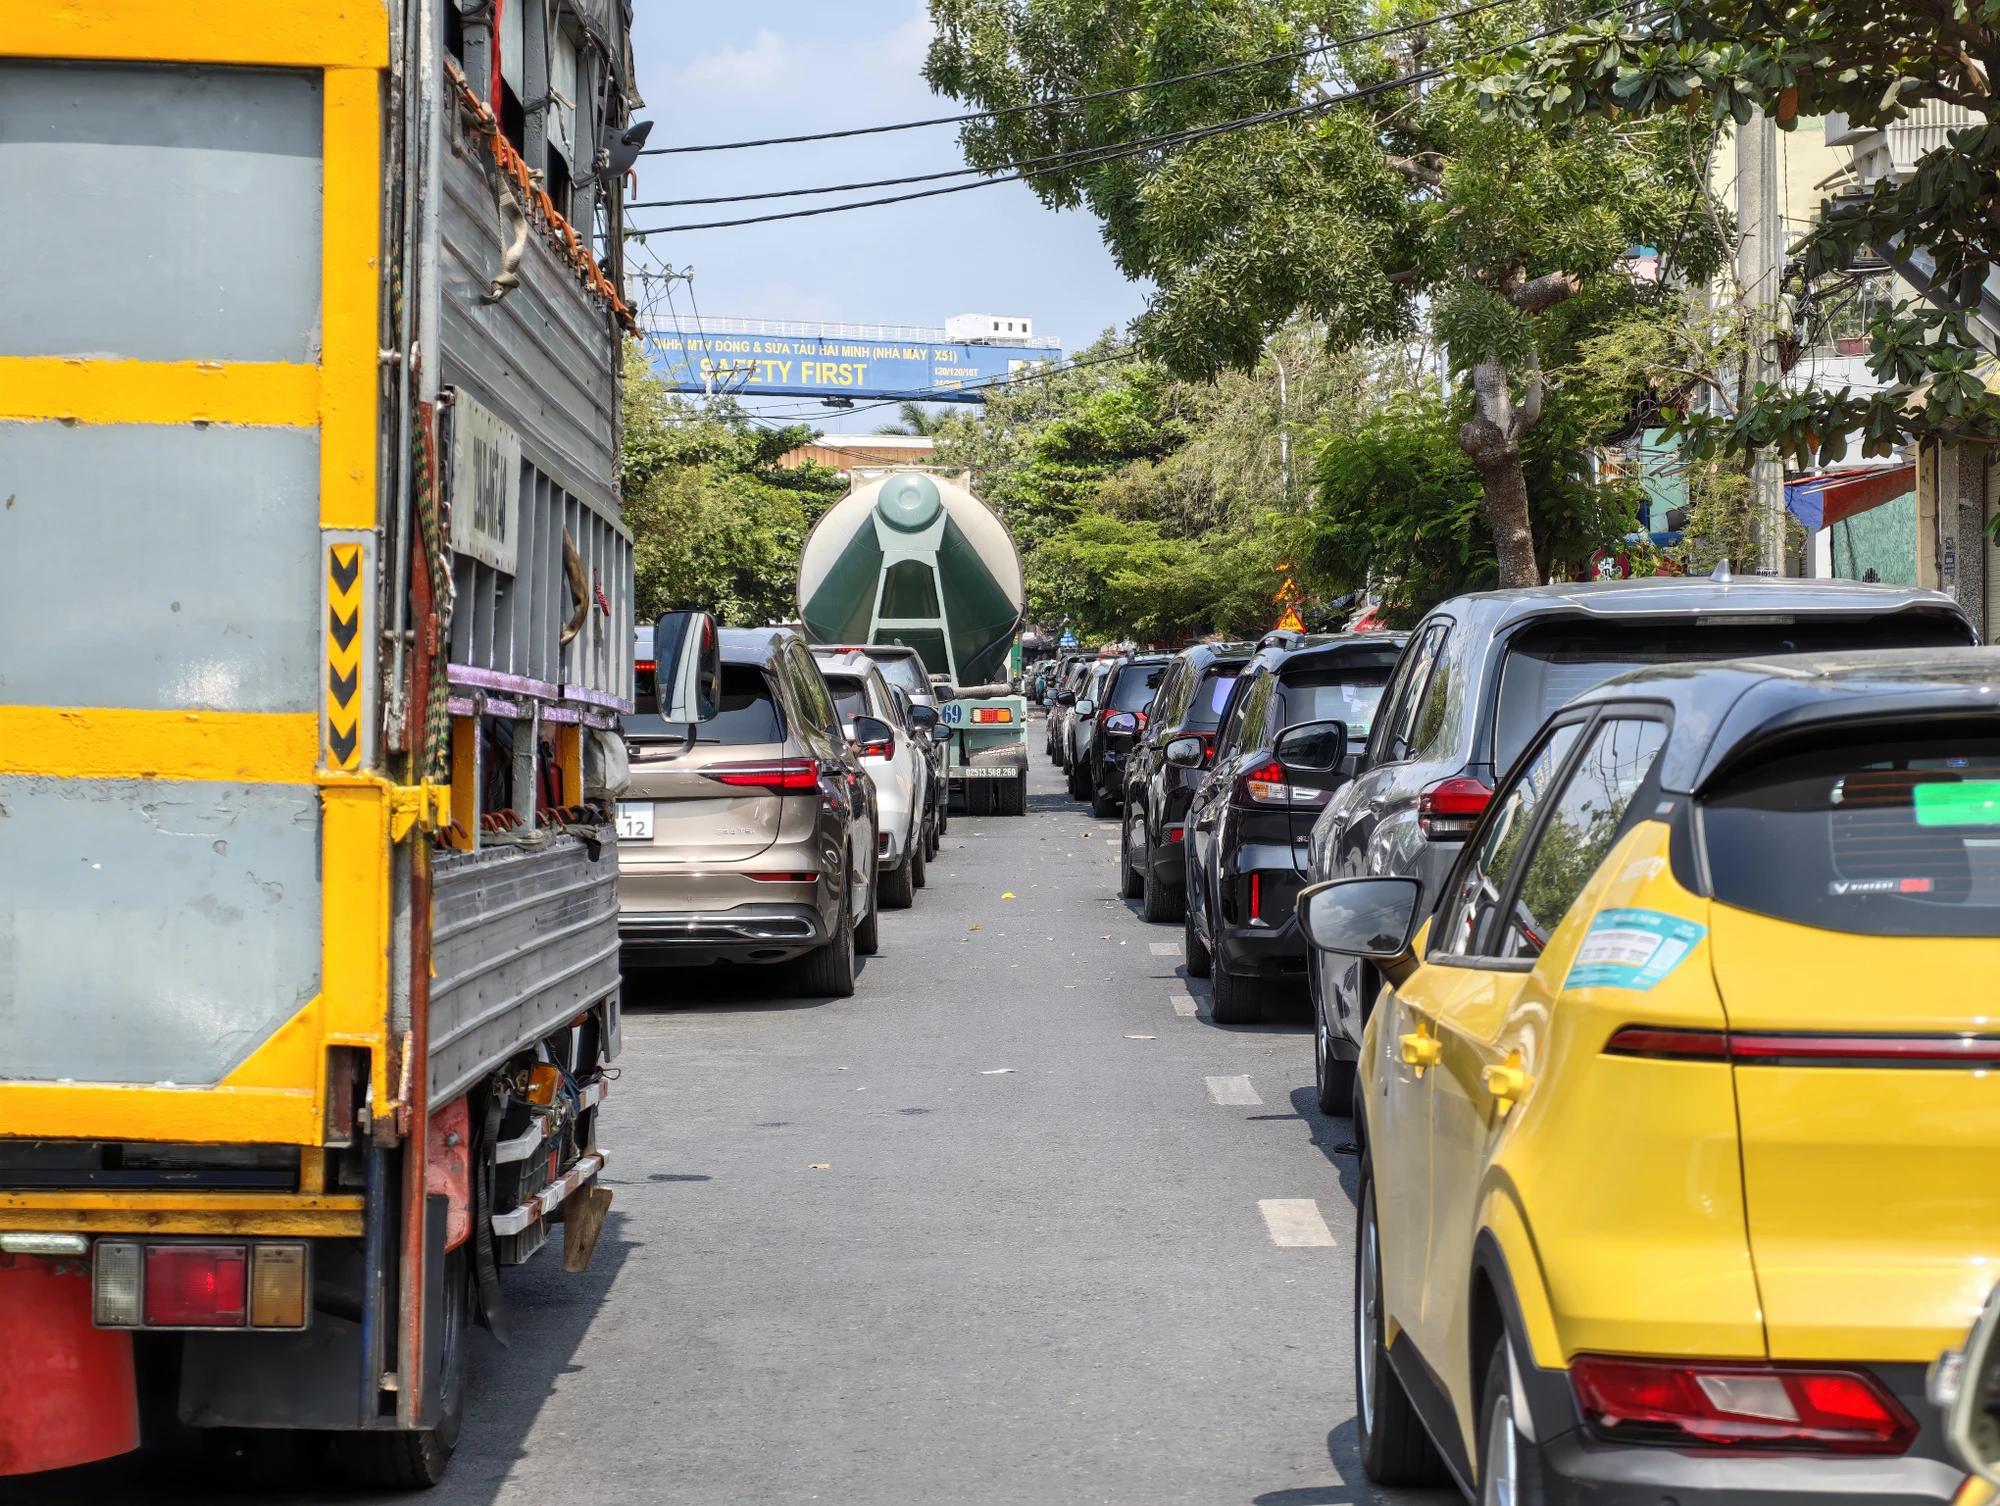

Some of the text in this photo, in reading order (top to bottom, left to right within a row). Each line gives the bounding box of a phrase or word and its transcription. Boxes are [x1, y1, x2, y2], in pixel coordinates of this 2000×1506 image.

[687, 339, 713, 351] MTV
[715, 336, 750, 353] ĐÓNG
[753, 340, 762, 353] &
[792, 340, 815, 356] TÀU
[841, 345, 870, 358] MINH
[903, 346, 927, 361] MÁY
[934, 349, 958, 364] X51)
[699, 358, 868, 386] SAFETY FIRST
[941, 704, 962, 725] 69
